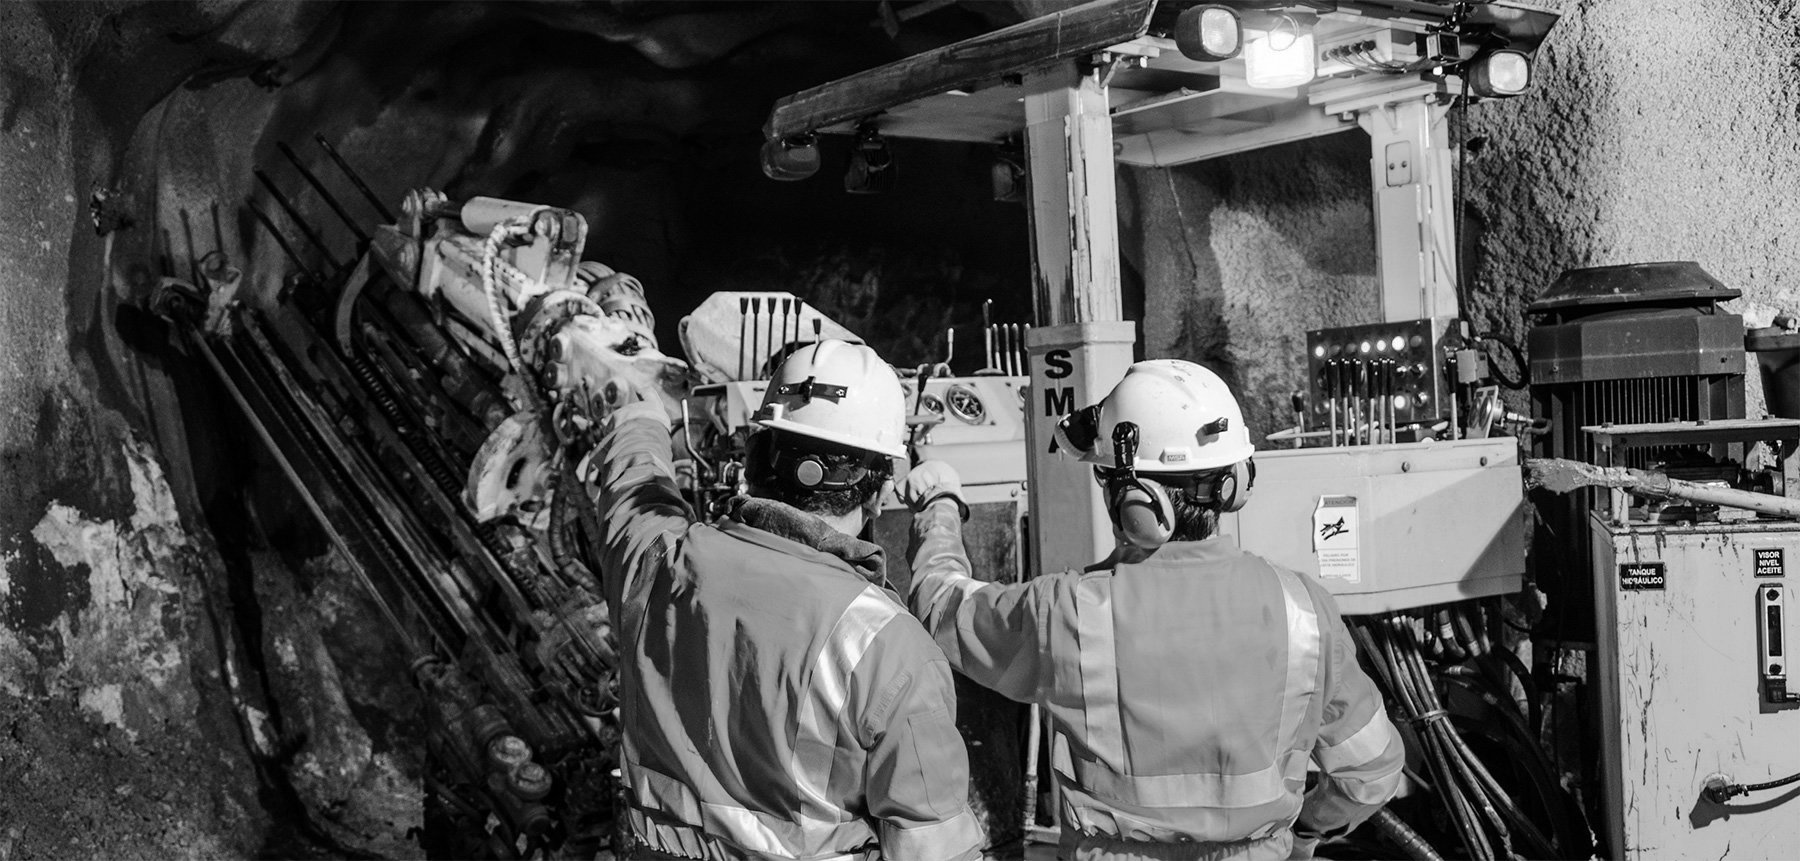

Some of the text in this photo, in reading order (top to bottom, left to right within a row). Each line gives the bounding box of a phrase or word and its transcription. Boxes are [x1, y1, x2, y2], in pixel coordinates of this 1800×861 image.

[1757, 551, 1780, 559] VISOR
[1628, 568, 1656, 576] TANQUE
[1757, 566, 1782, 574] ACEITE
